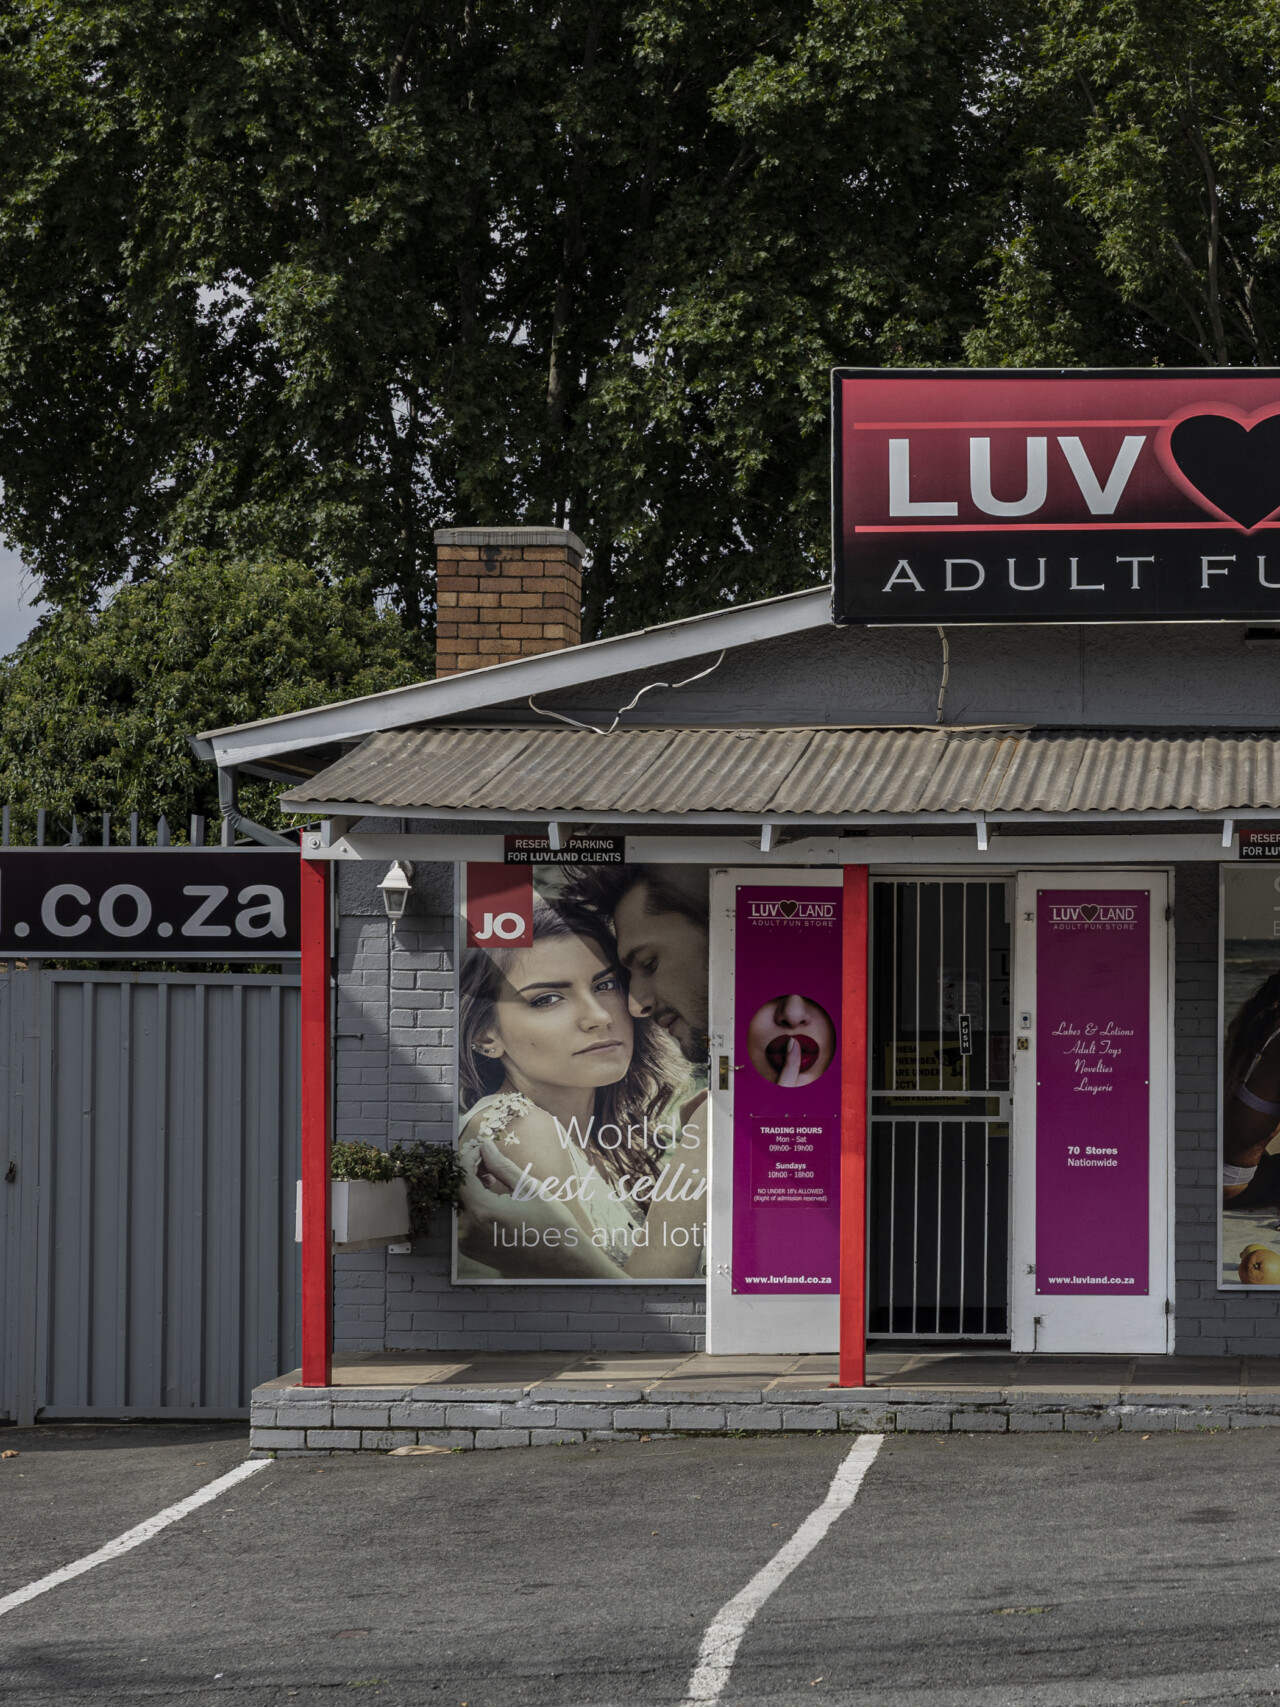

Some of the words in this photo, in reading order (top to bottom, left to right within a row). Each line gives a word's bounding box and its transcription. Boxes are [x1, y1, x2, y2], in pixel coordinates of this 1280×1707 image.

[889, 435, 1146, 517] LUV
[882, 555, 1154, 592] ADULT
[515, 840, 567, 849] RESERD
[569, 840, 613, 849] PARKING
[1242, 846, 1263, 855] FOR
[508, 852, 527, 861] FOR
[530, 852, 578, 861] LUVLAND
[581, 852, 621, 861] CLIENTS
[0, 868, 286, 938] .co.za
[752, 904, 779, 916] LUV
[799, 905, 834, 917] LAND
[1053, 908, 1080, 920] LUV
[1100, 908, 1134, 920] LAND
[961, 1021, 969, 1048] PUSH
[1052, 1021, 1080, 1036] Lubes
[1084, 1023, 1098, 1036] &
[1099, 1021, 1134, 1036] Lotions
[1063, 1040, 1096, 1054] Adult
[1099, 1040, 1122, 1058] Toys
[1074, 1059, 1113, 1074] Novelties
[1074, 1077, 1113, 1095] Lingerie
[553, 1116, 701, 1150] Worlds
[1067, 1146, 1080, 1155] 70
[1085, 1146, 1118, 1155] Stores
[1067, 1158, 1118, 1167] Nationwide
[511, 1162, 597, 1202] best
[493, 1222, 578, 1247] lubes
[591, 1222, 649, 1247] and
[745, 1276, 832, 1284] www.luvland.co.za
[1048, 1276, 1135, 1284] www.luvland.co.za
